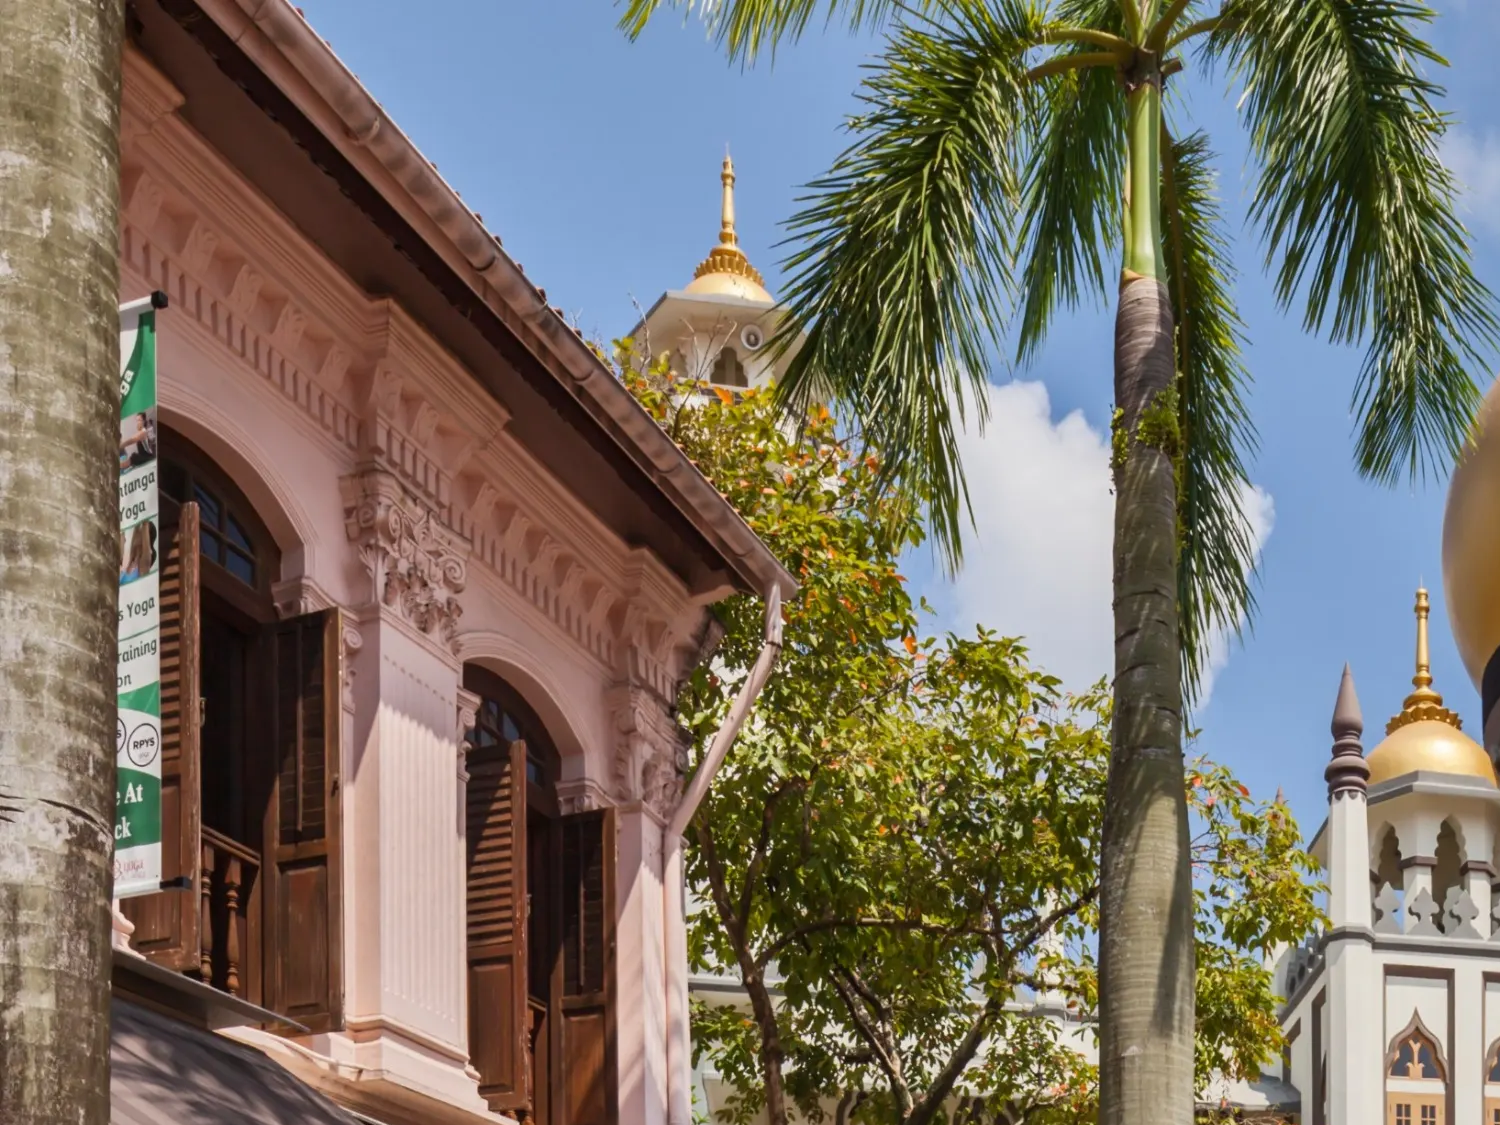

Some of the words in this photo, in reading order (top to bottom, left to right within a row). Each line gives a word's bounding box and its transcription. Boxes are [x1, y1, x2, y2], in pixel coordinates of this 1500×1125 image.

[127, 597, 155, 619] Yoga
[118, 639, 158, 664] raining
[133, 737, 155, 750] RPYS
[124, 782, 143, 804] At
